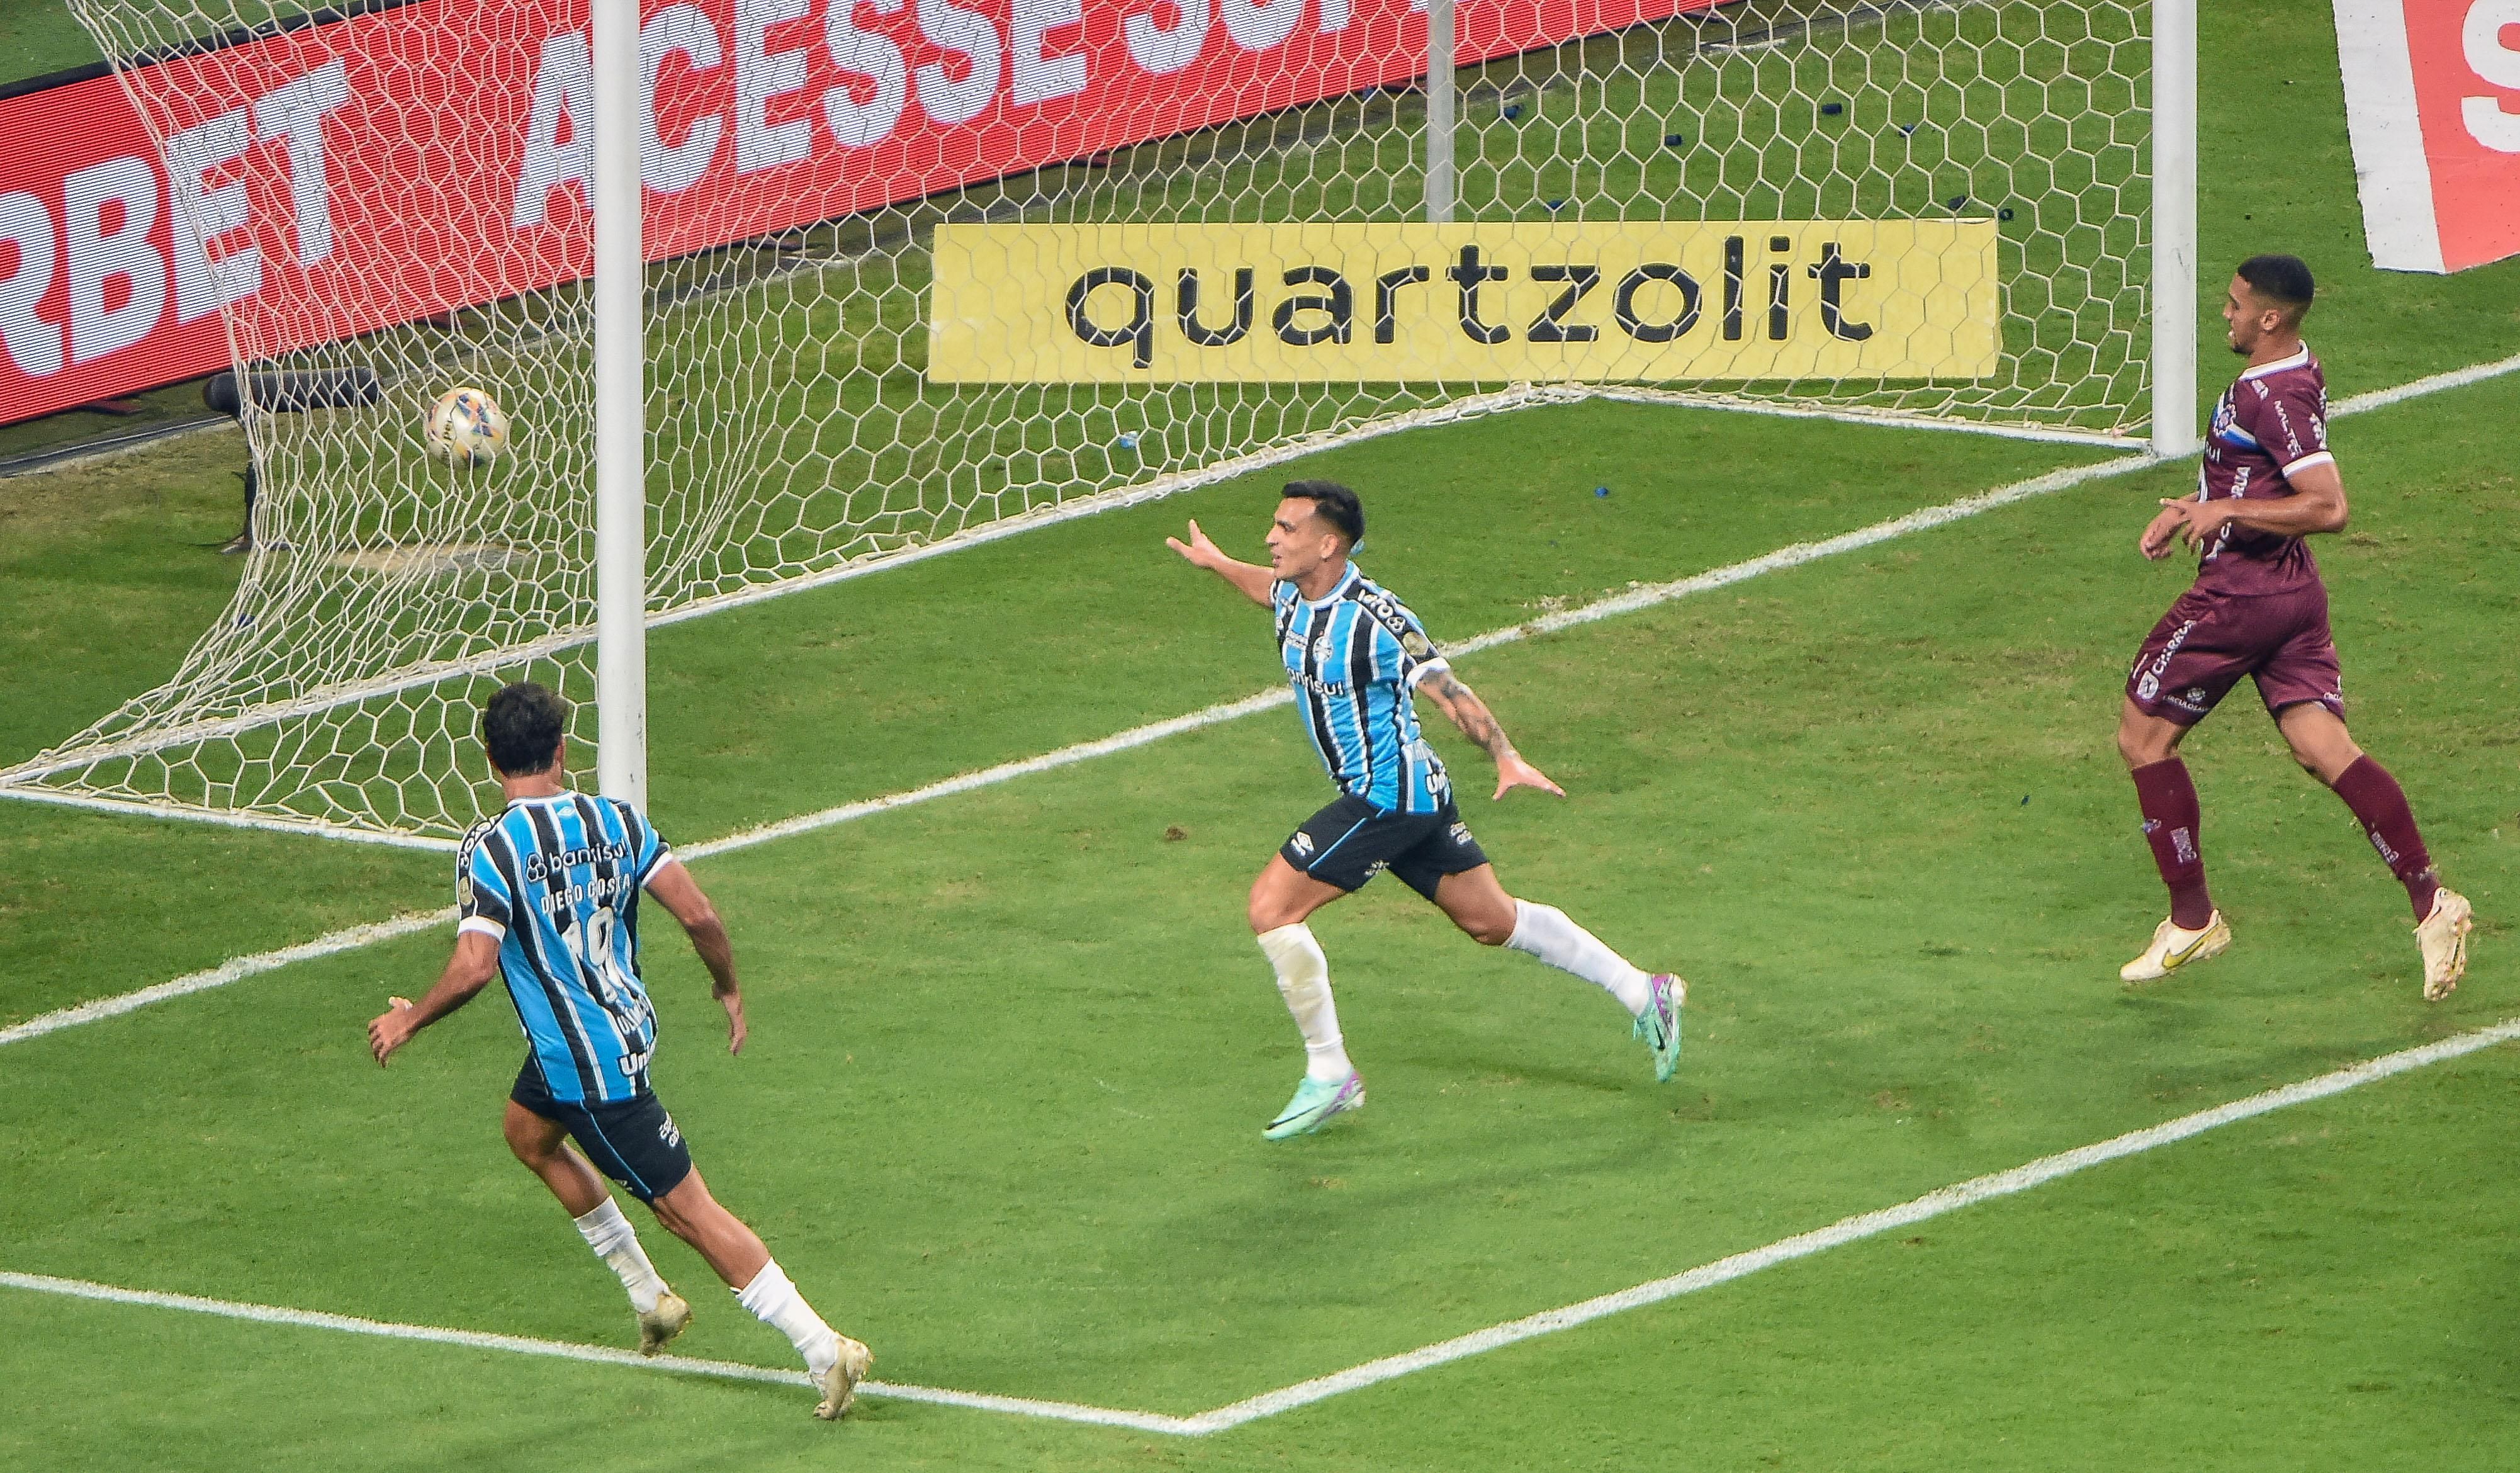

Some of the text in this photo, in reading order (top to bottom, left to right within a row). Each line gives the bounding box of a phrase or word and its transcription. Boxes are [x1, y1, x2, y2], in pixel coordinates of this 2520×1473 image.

[513, 0, 1087, 229] ACESSE
[1065, 235, 1874, 370] quartzolit
[541, 873, 631, 913] DIEGO COSTA
[549, 836, 629, 874] banrisul
[561, 906, 625, 1003] 19
